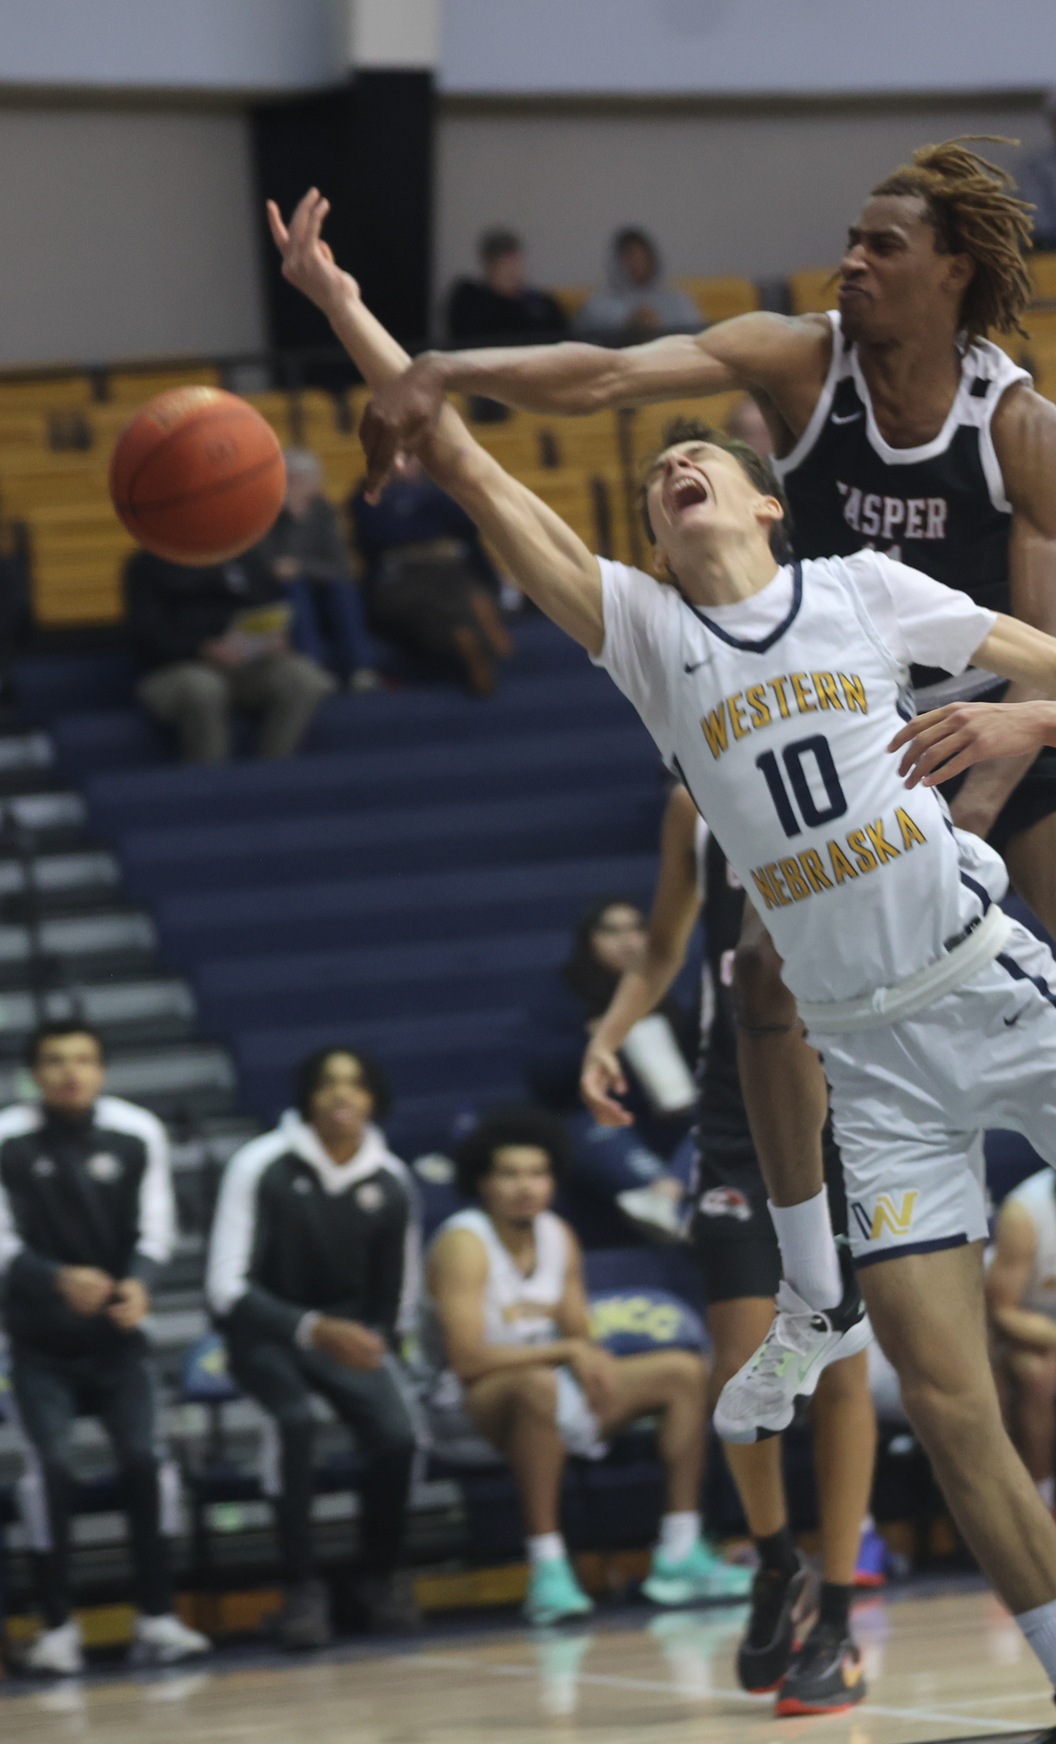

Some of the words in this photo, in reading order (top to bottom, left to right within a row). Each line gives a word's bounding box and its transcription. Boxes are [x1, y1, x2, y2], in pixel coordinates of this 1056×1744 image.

[836, 480, 948, 540] ASPER
[701, 671, 869, 760] WESTERN
[756, 733, 849, 839] 10
[750, 806, 927, 910] NEBRASKA
